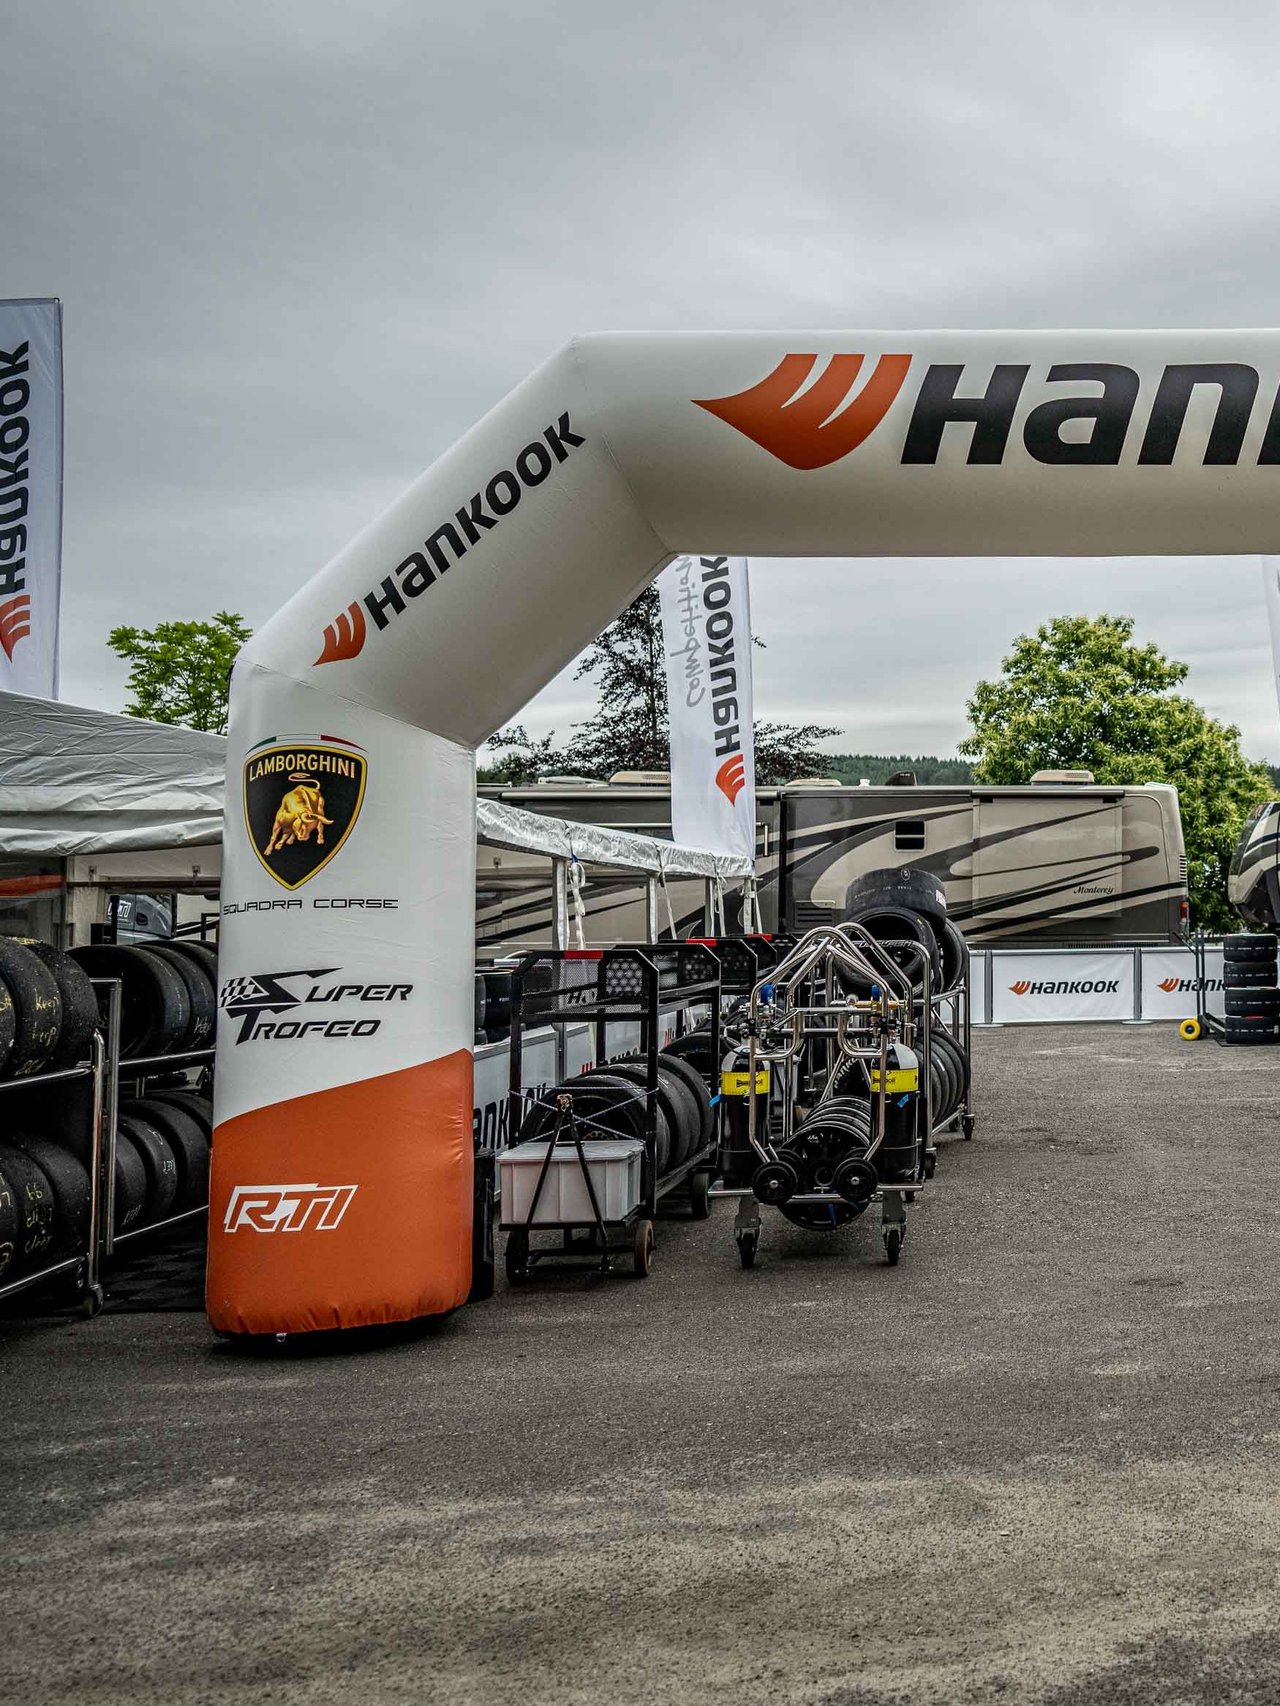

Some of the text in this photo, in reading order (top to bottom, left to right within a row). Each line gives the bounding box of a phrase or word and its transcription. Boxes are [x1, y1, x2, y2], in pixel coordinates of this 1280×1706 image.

[363, 410, 587, 632] HANKOOK
[247, 750, 357, 783] LAMBORGHINI
[222, 897, 399, 912] SQUADRA CORSE
[1030, 978, 1119, 995] HANKOOK
[223, 1184, 359, 1233] RTI
